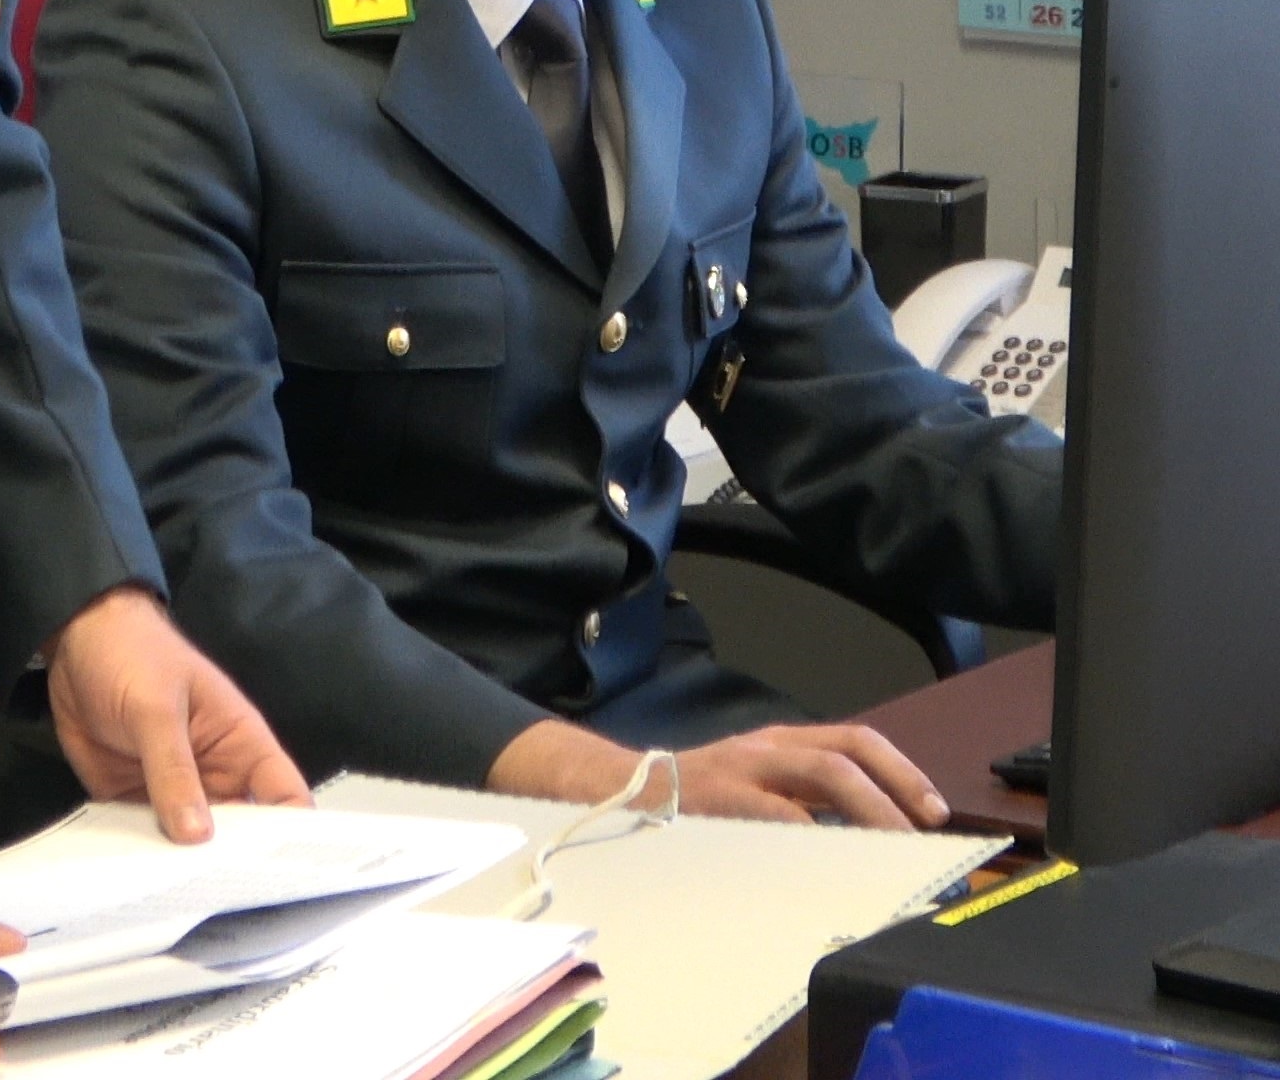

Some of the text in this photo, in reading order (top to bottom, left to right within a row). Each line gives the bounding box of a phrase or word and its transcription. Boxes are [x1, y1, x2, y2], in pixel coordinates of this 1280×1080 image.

[985, 4, 1006, 22] 52
[1031, 5, 1063, 27] 26
[810, 133, 864, 159] OSB
